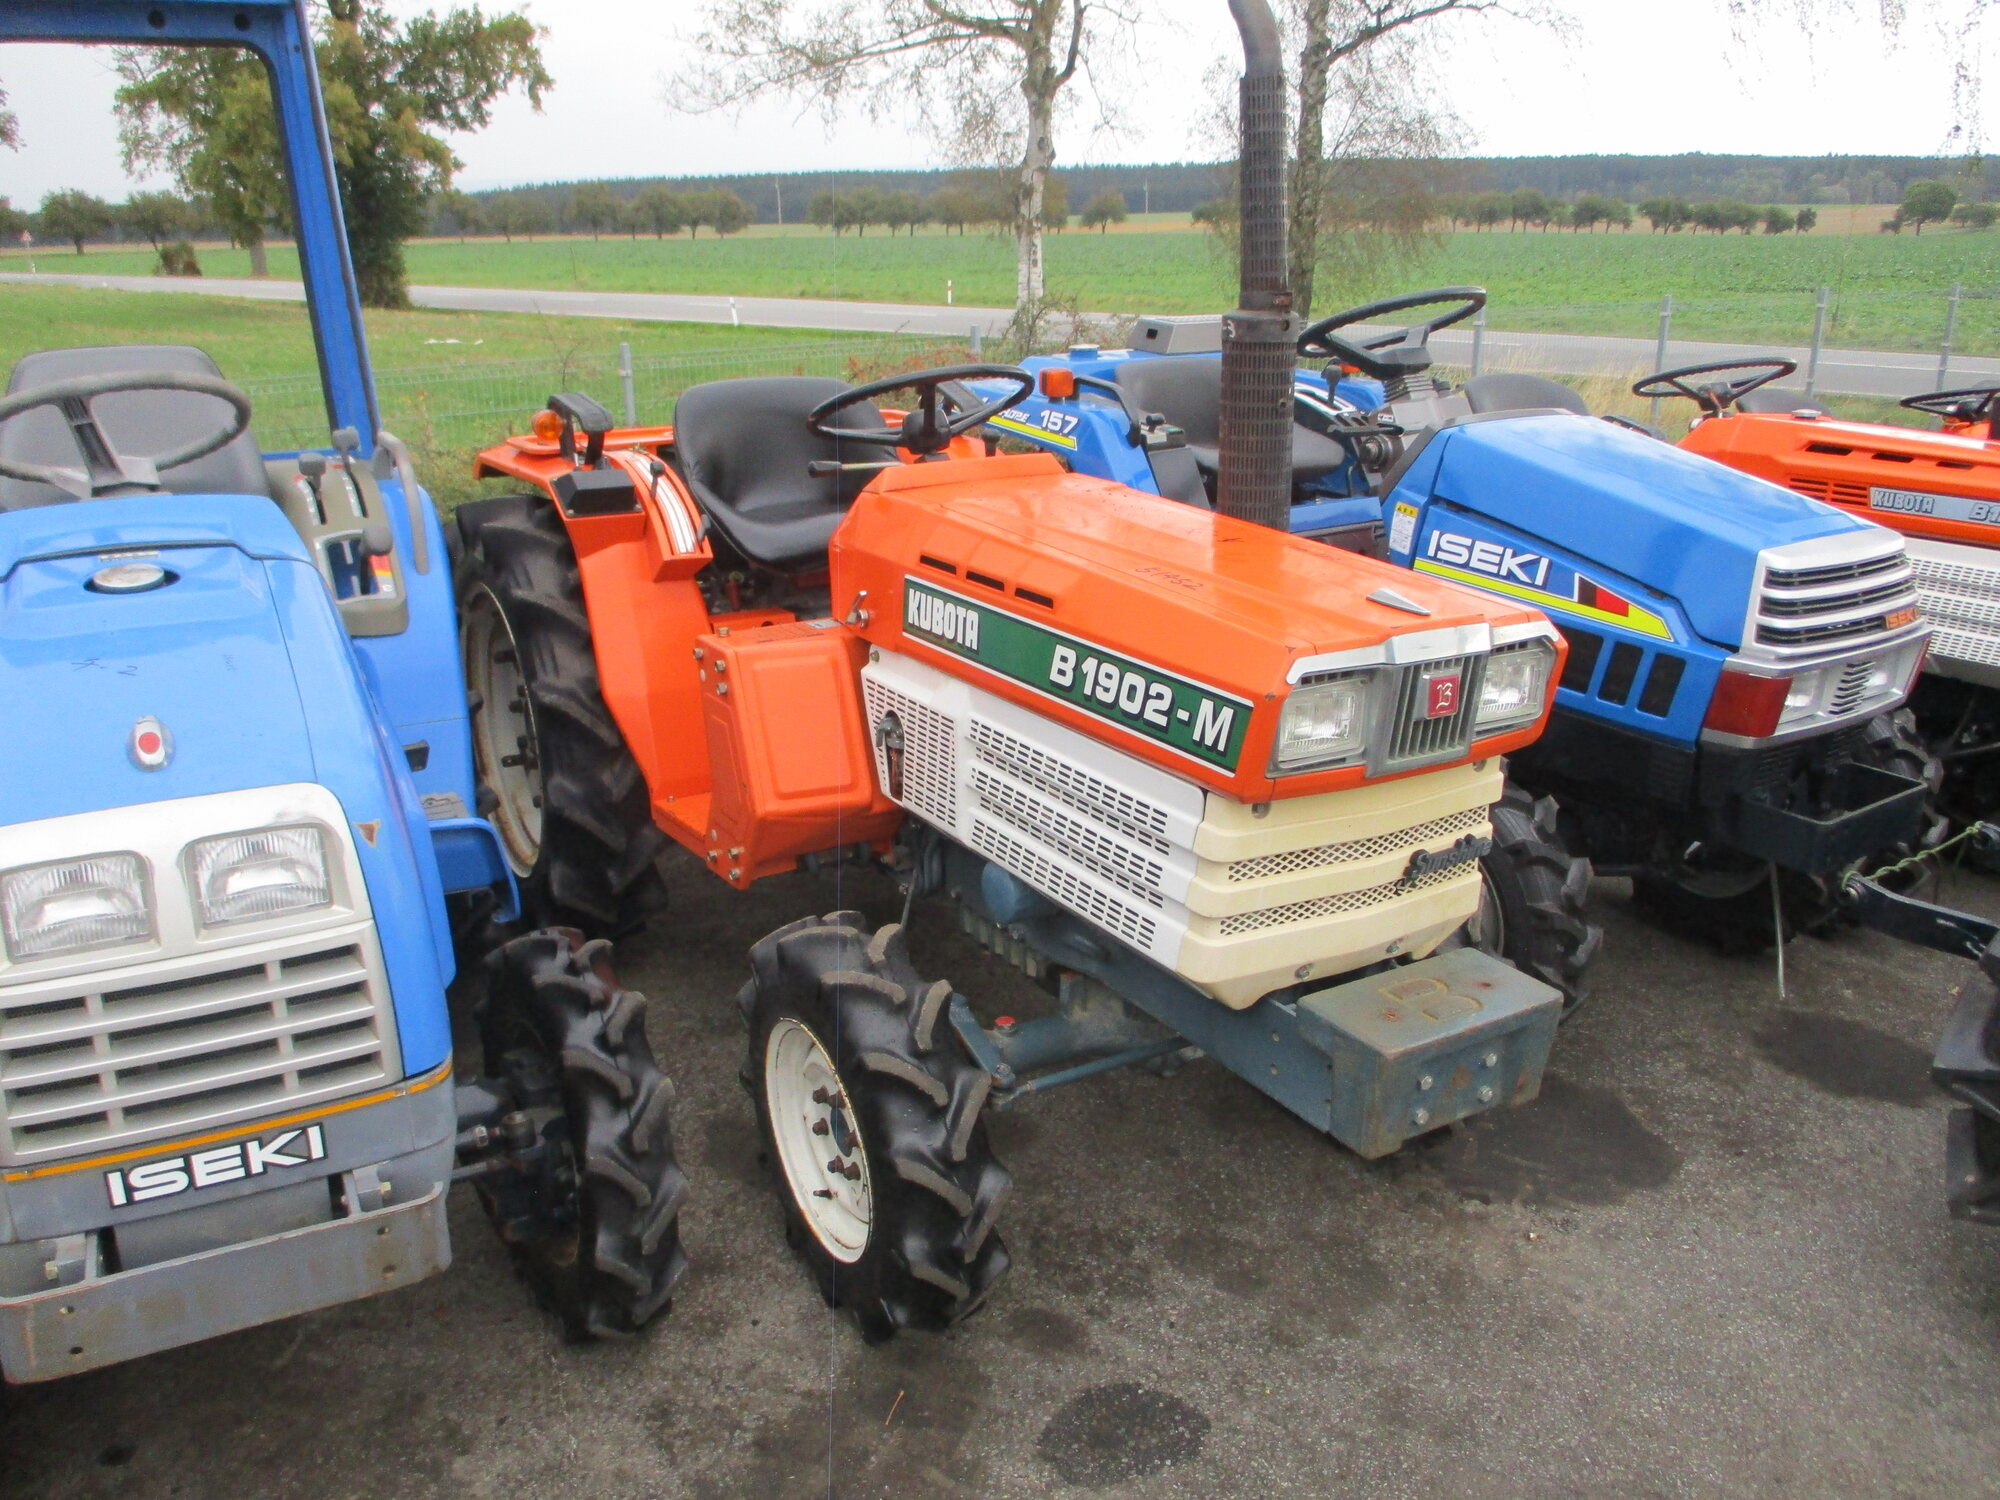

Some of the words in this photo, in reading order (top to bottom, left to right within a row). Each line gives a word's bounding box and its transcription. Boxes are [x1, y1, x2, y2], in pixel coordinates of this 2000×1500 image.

[1040, 409, 1079, 435] 157
[1873, 489, 1934, 513] KUBOTA
[1427, 529, 1550, 586] ISEKI
[908, 587, 980, 652] KUBOTA
[1049, 643, 1235, 752] B1902-M
[105, 1125, 325, 1206] ISEKI
